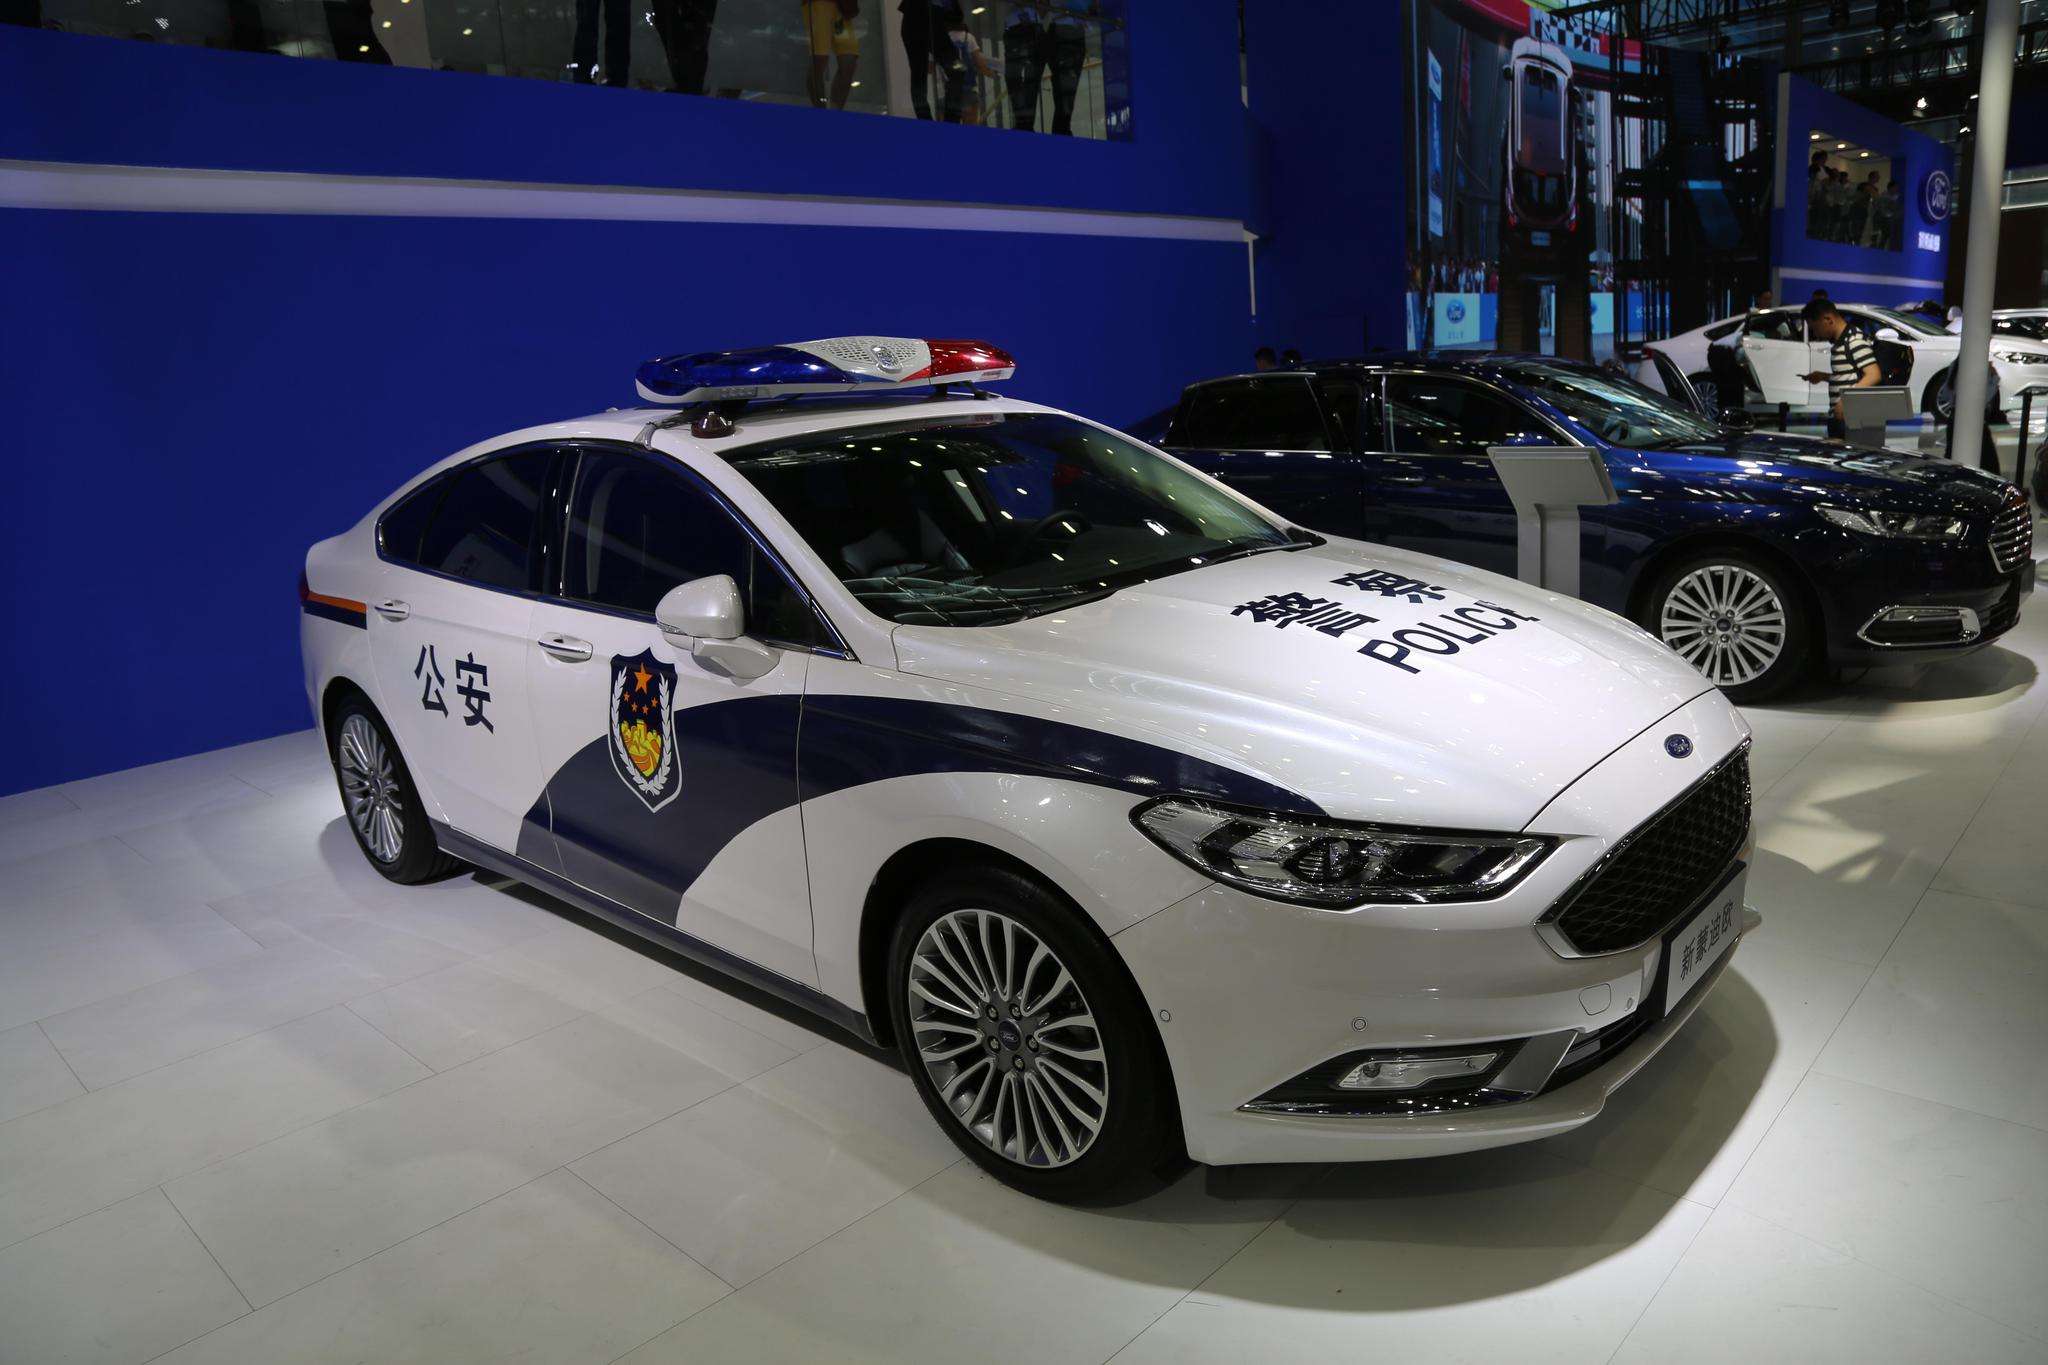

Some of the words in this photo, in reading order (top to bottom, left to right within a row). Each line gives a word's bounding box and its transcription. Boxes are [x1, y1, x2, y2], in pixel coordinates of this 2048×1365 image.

[1230, 568, 1447, 637] 警察
[1357, 599, 1541, 674] POLICE
[414, 644, 494, 734] 公安
[1680, 899, 1735, 981] 新蒙迪欧
